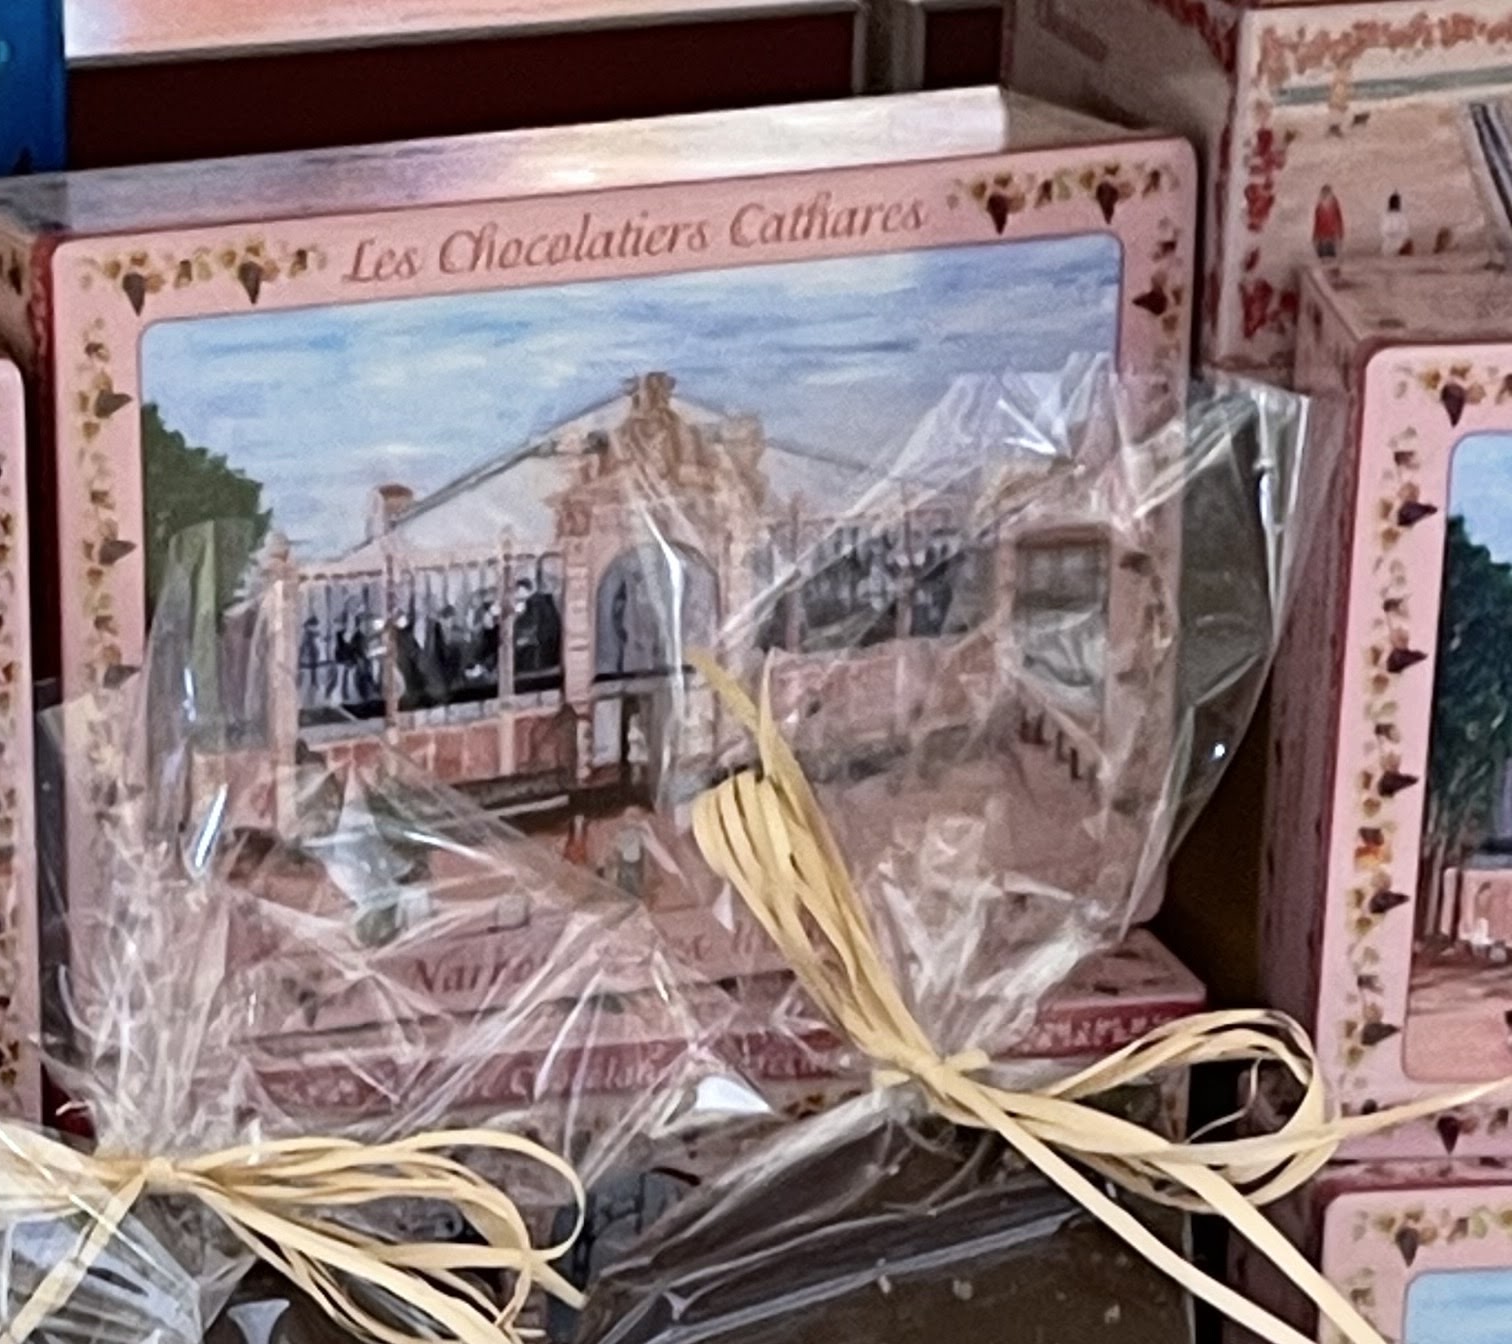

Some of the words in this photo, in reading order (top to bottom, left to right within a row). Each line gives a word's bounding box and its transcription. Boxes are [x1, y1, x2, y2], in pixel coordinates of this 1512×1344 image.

[341, 236, 421, 284] Les
[439, 209, 711, 275] Chocolatiers
[729, 190, 926, 249] Cathares
